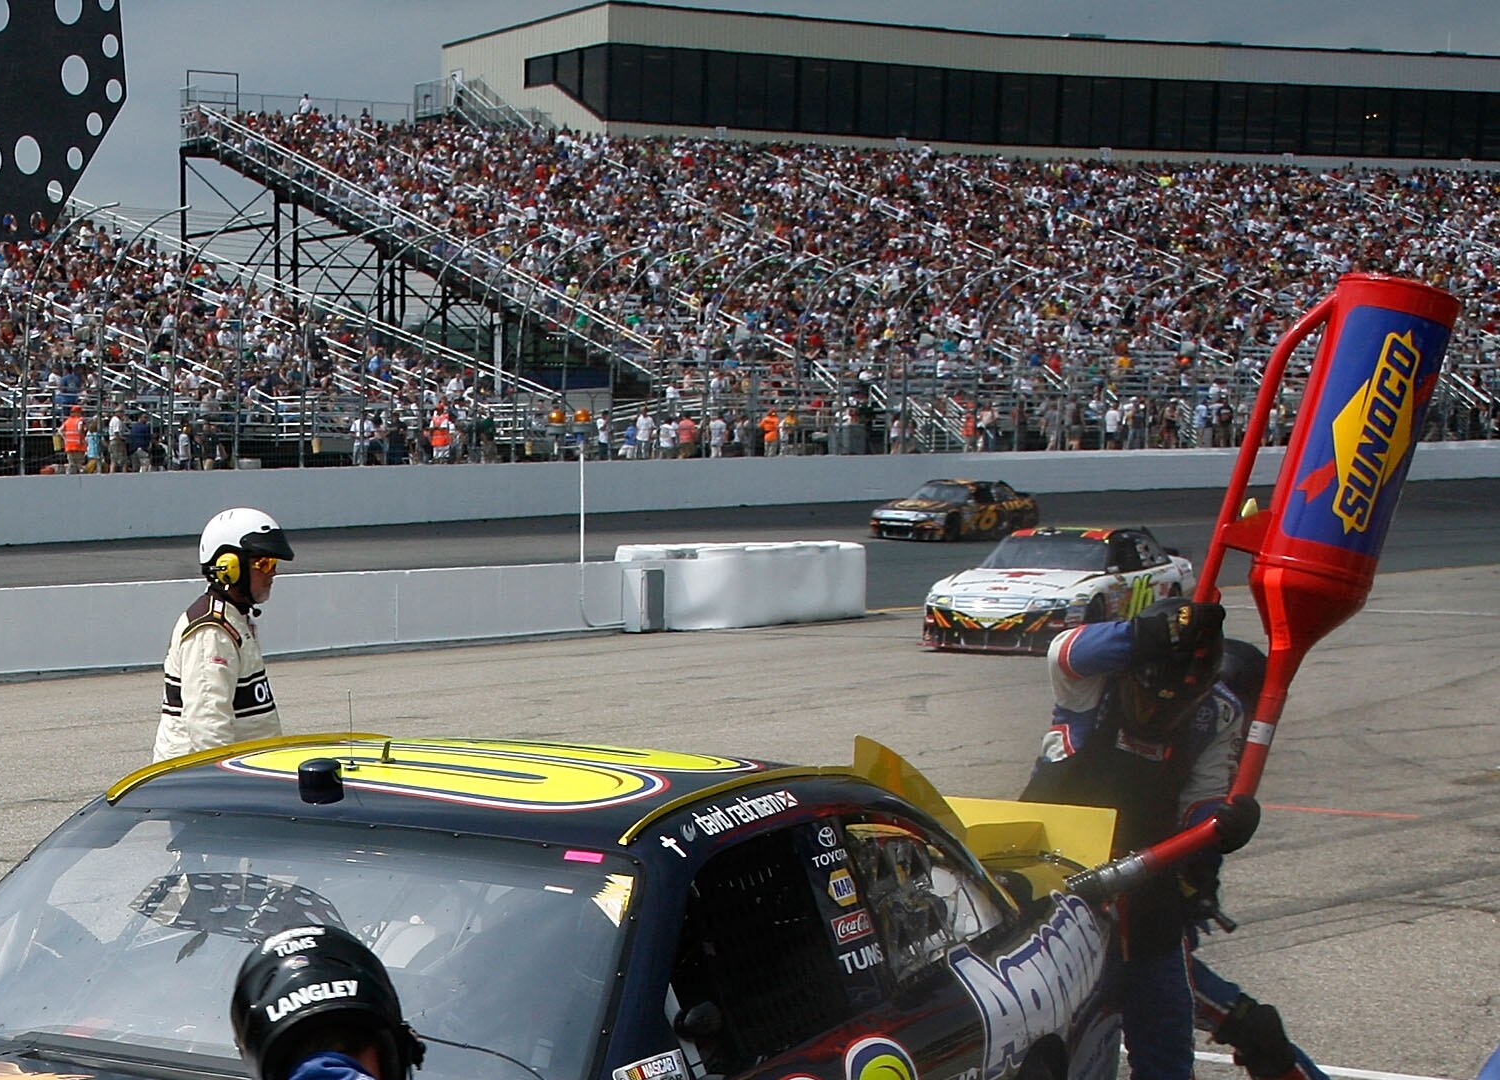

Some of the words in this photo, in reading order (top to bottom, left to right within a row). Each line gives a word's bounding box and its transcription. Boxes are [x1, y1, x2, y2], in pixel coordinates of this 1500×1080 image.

[1339, 337, 1417, 527] SUNOCO
[692, 805, 735, 836] david
[812, 849, 848, 868] TOYOTA
[274, 937, 317, 957] TUMS
[838, 942, 884, 975] TUMS
[266, 980, 358, 1022] LANGLEY
[642, 1056, 676, 1078] NASCAR
